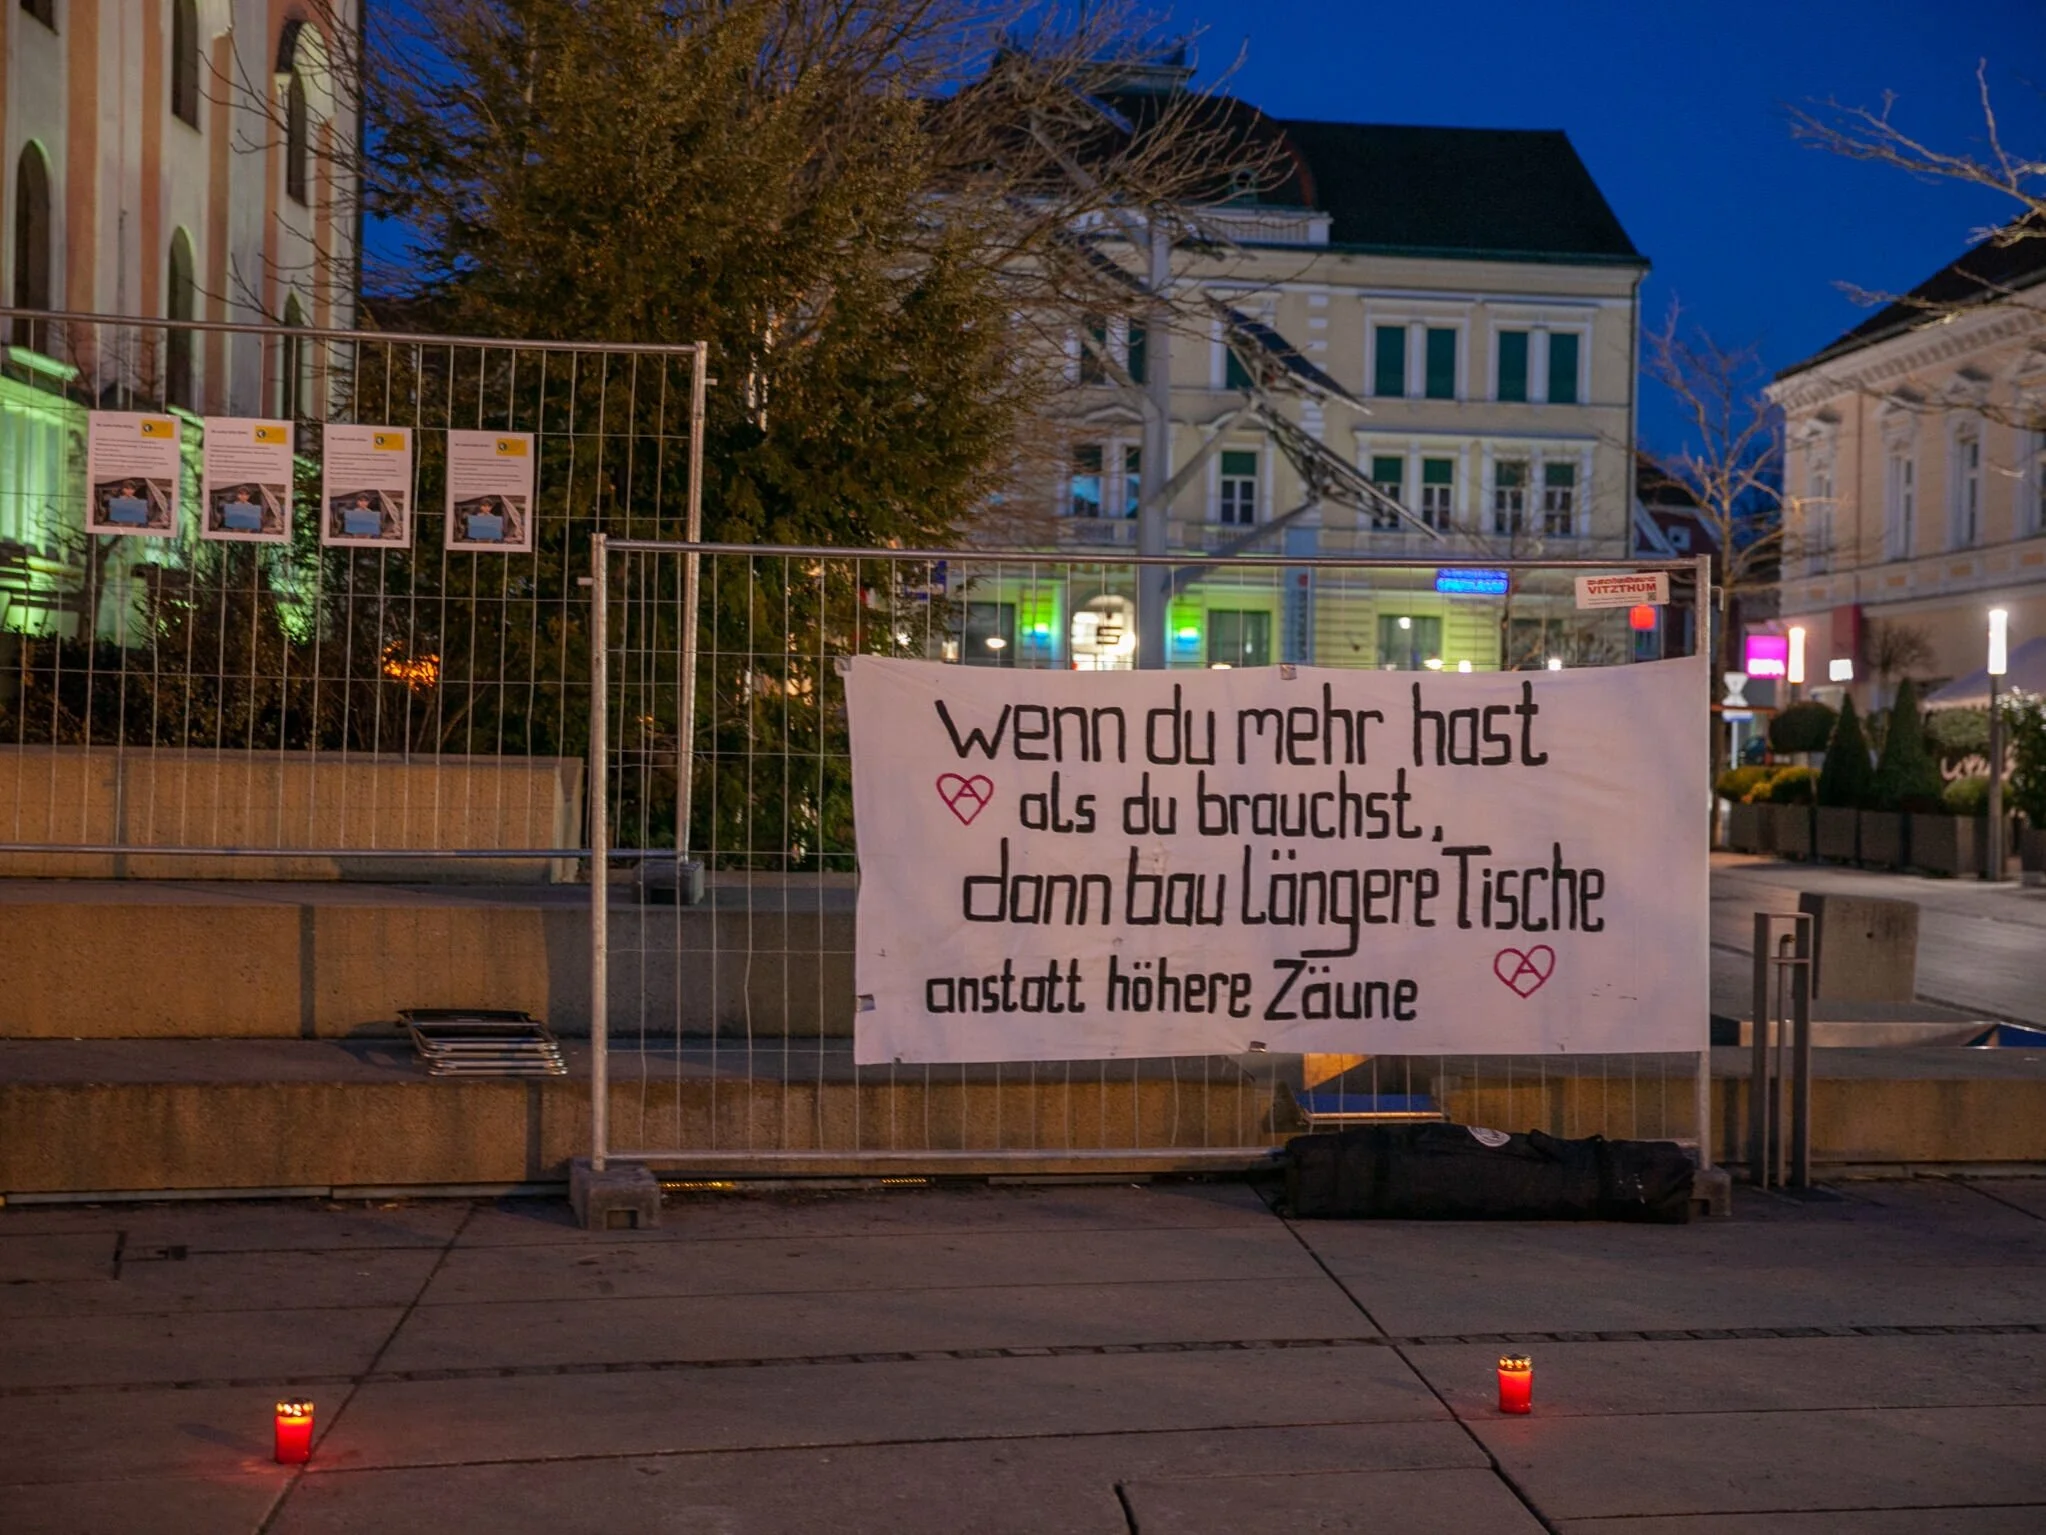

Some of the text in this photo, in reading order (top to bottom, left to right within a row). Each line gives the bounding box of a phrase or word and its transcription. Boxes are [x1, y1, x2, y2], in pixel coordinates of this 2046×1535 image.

[1587, 583, 1657, 594] VITZTHUM
[1145, 683, 1216, 766] du
[1237, 682, 1385, 766] mehr
[1411, 680, 1549, 768] hast
[1019, 767, 1444, 843] als du brauchst,
[962, 836, 1113, 926] dann
[1125, 845, 1227, 927] bau
[1440, 841, 1605, 933] Tische
[925, 954, 1419, 1022] anstatt höhere Zäune
